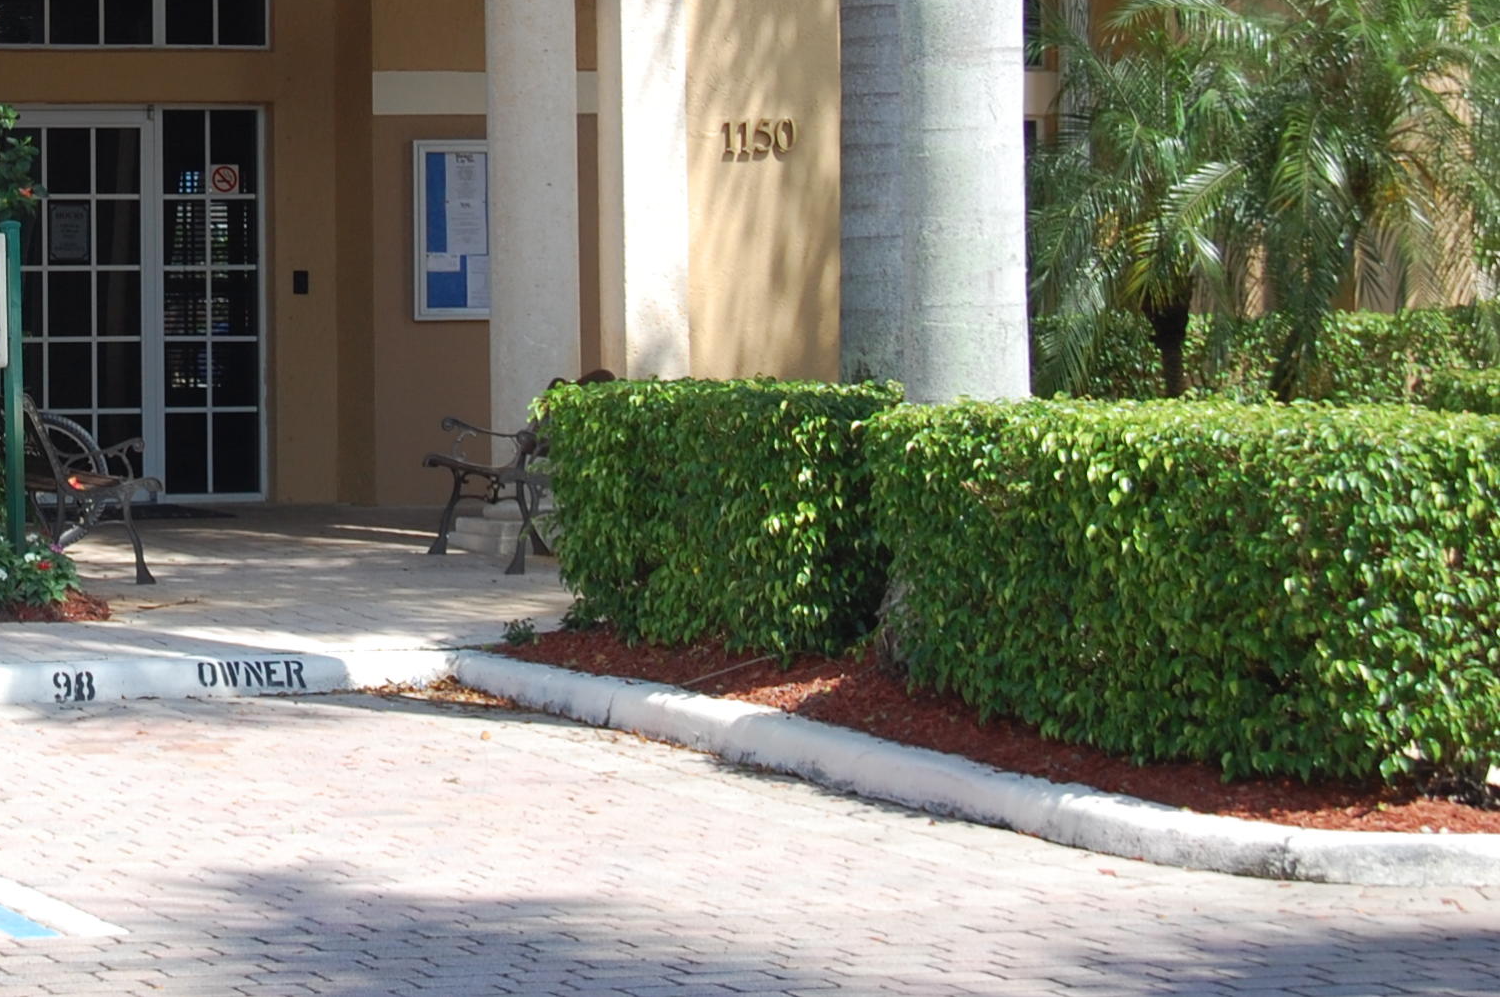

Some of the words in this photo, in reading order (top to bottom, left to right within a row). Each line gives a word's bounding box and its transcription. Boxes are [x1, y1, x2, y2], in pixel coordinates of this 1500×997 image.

[720, 117, 799, 154] 1150
[53, 671, 95, 702] 98
[197, 659, 309, 689] OWNER
